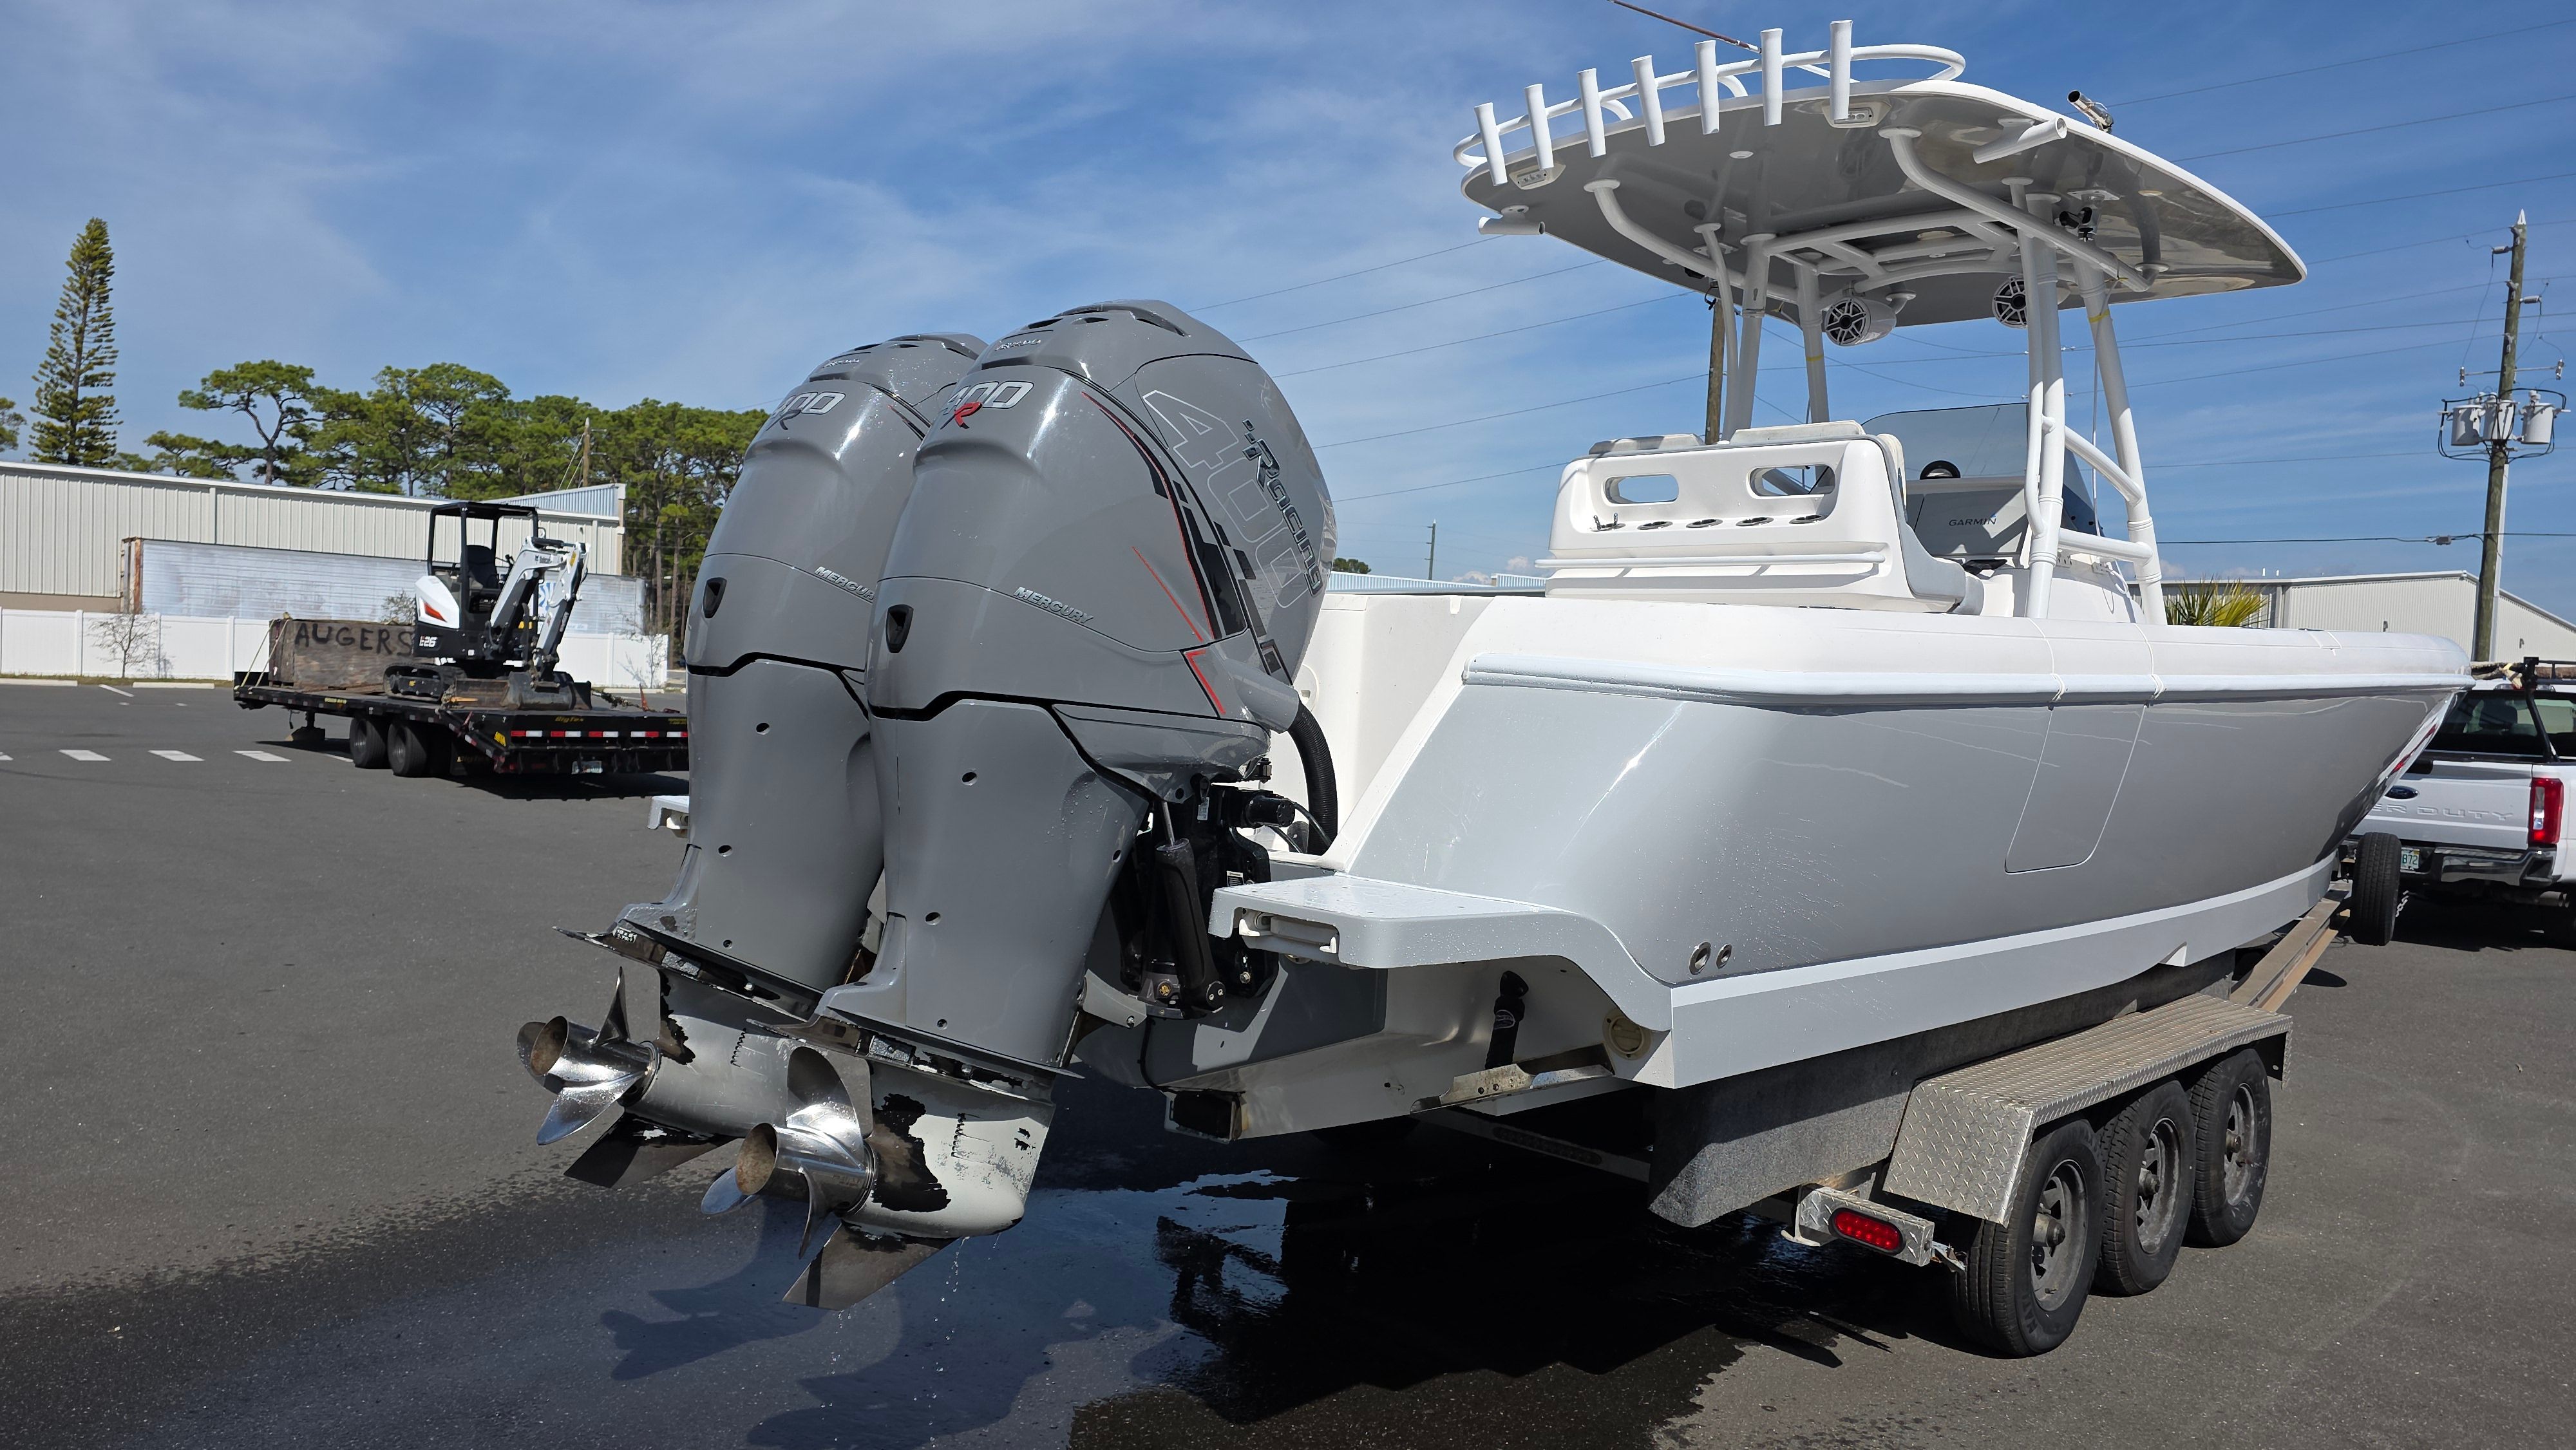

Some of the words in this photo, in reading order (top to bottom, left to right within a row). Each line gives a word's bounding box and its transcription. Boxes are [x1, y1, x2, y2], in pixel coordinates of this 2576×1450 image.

[1142, 390, 1309, 608] 400
[1949, 518, 1997, 526] GARMIN
[814, 566, 875, 601] MERCUR
[1013, 587, 1094, 624] MERCURY
[294, 623, 413, 656] AUGERS
[419, 635, 437, 648] E26
[2417, 805, 2513, 822] DUTY
